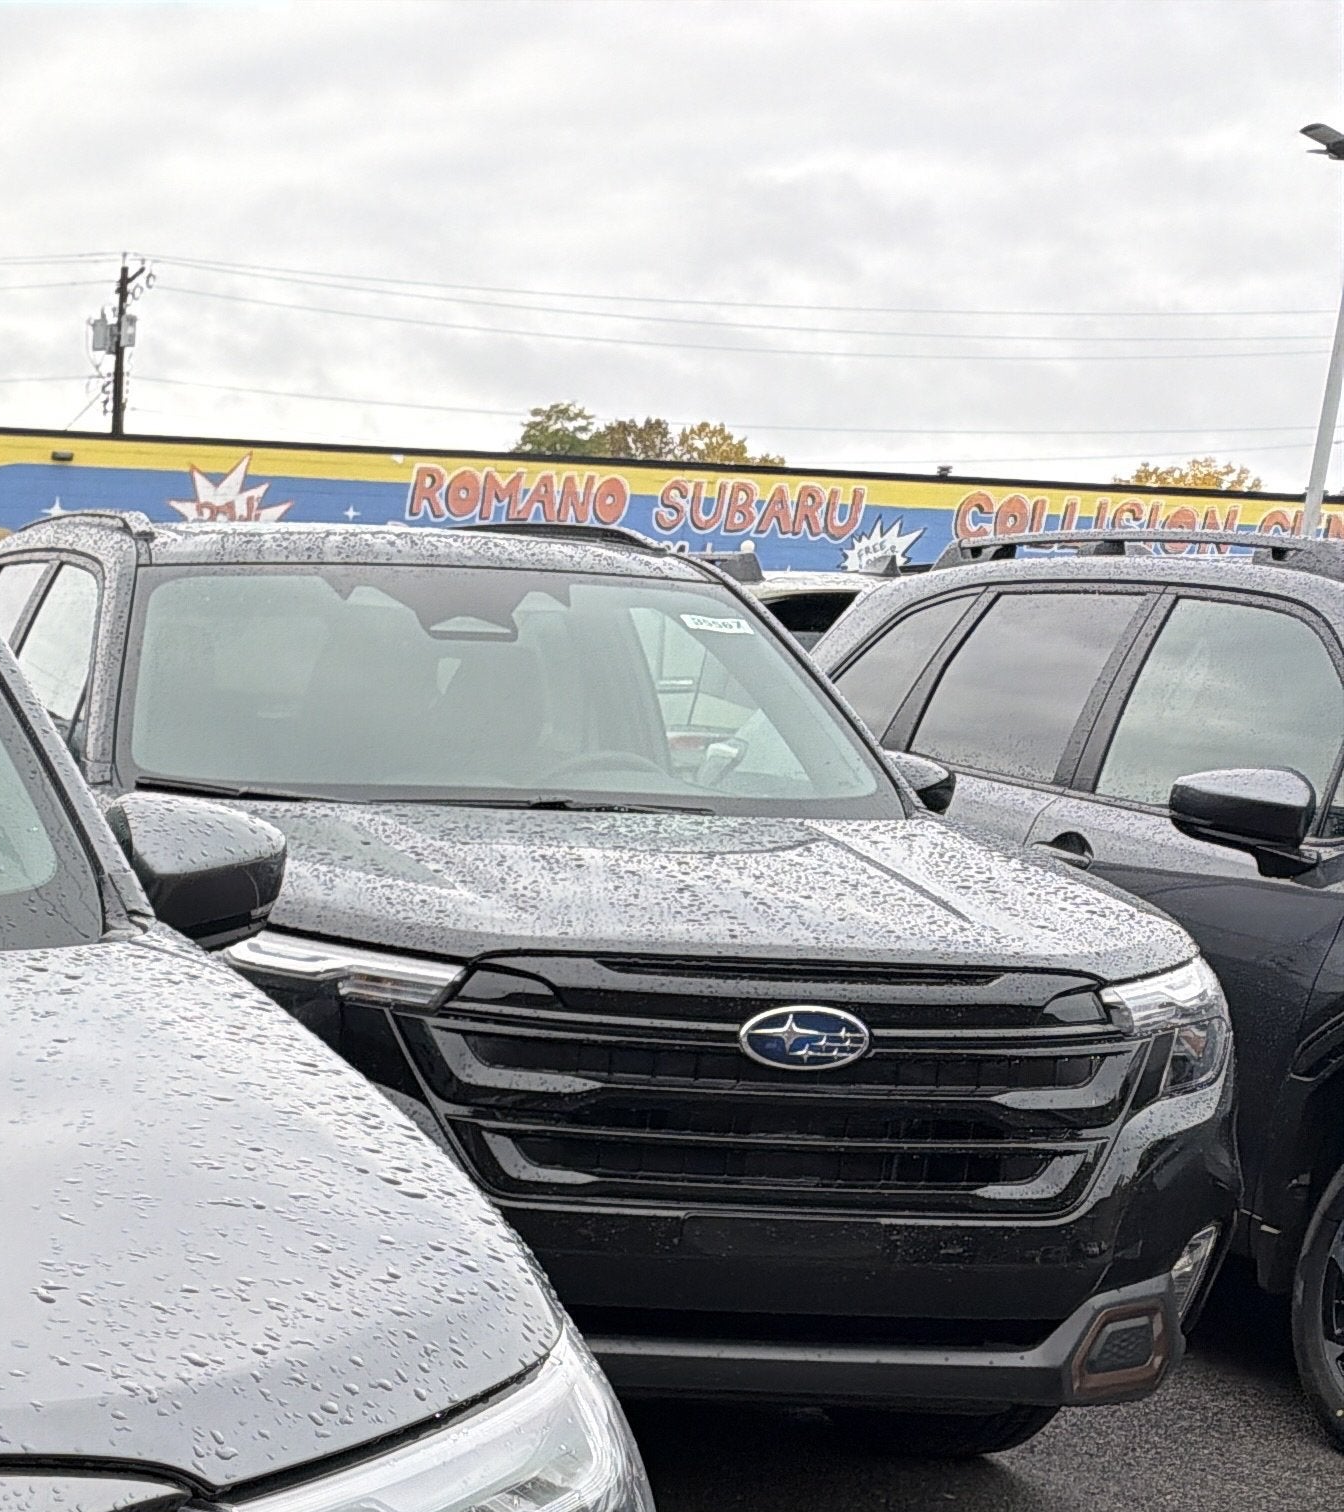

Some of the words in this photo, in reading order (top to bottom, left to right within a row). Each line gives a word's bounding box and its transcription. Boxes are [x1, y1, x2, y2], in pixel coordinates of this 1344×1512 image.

[407, 464, 629, 525] ROMANO
[653, 477, 866, 542] SUBARU
[857, 539, 887, 559] FREE
